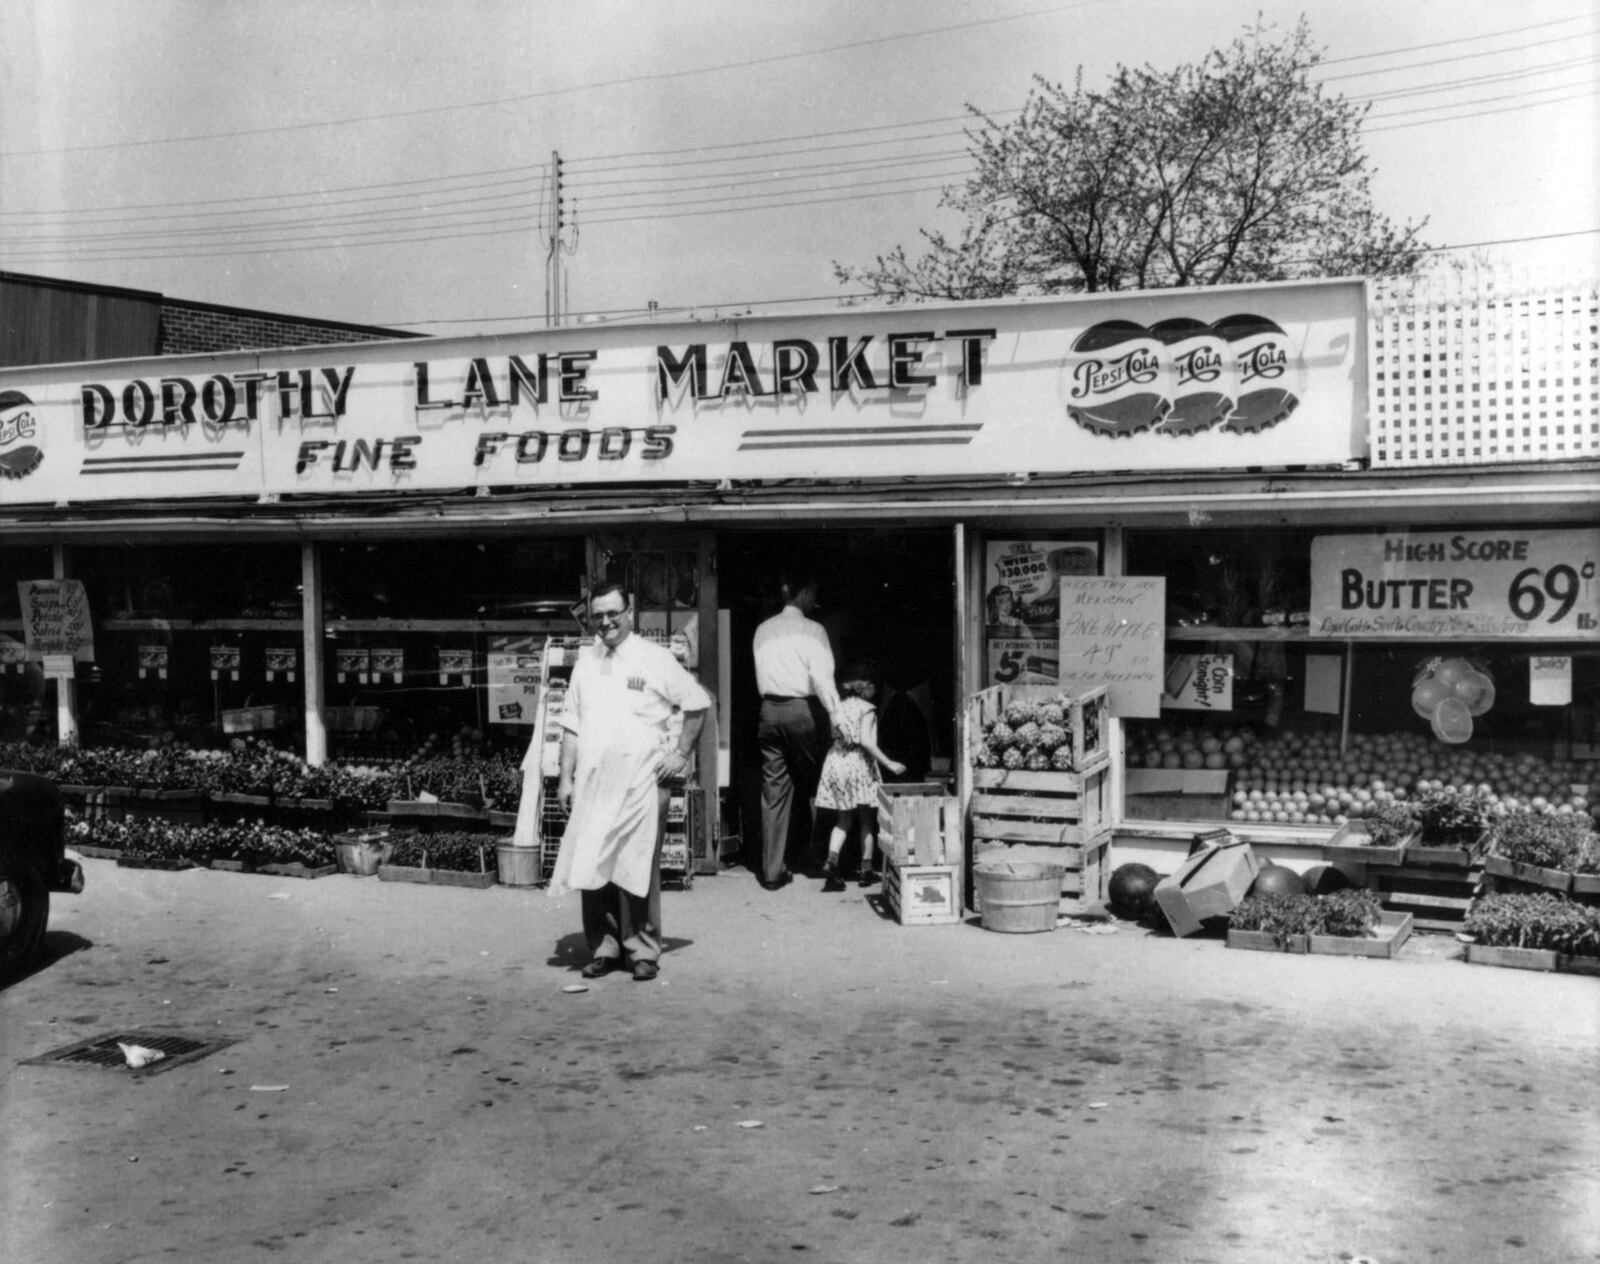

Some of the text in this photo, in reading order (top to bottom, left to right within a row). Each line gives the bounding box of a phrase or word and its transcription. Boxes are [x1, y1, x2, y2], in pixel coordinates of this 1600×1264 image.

[80, 328, 997, 429] DOROTHY LANE MARKET
[295, 424, 677, 475] FINE FOODS
[1383, 535, 1530, 563] HIGH SCORE
[1341, 568, 1474, 610] BUTTER
[1192, 658, 1213, 707] tonight!
